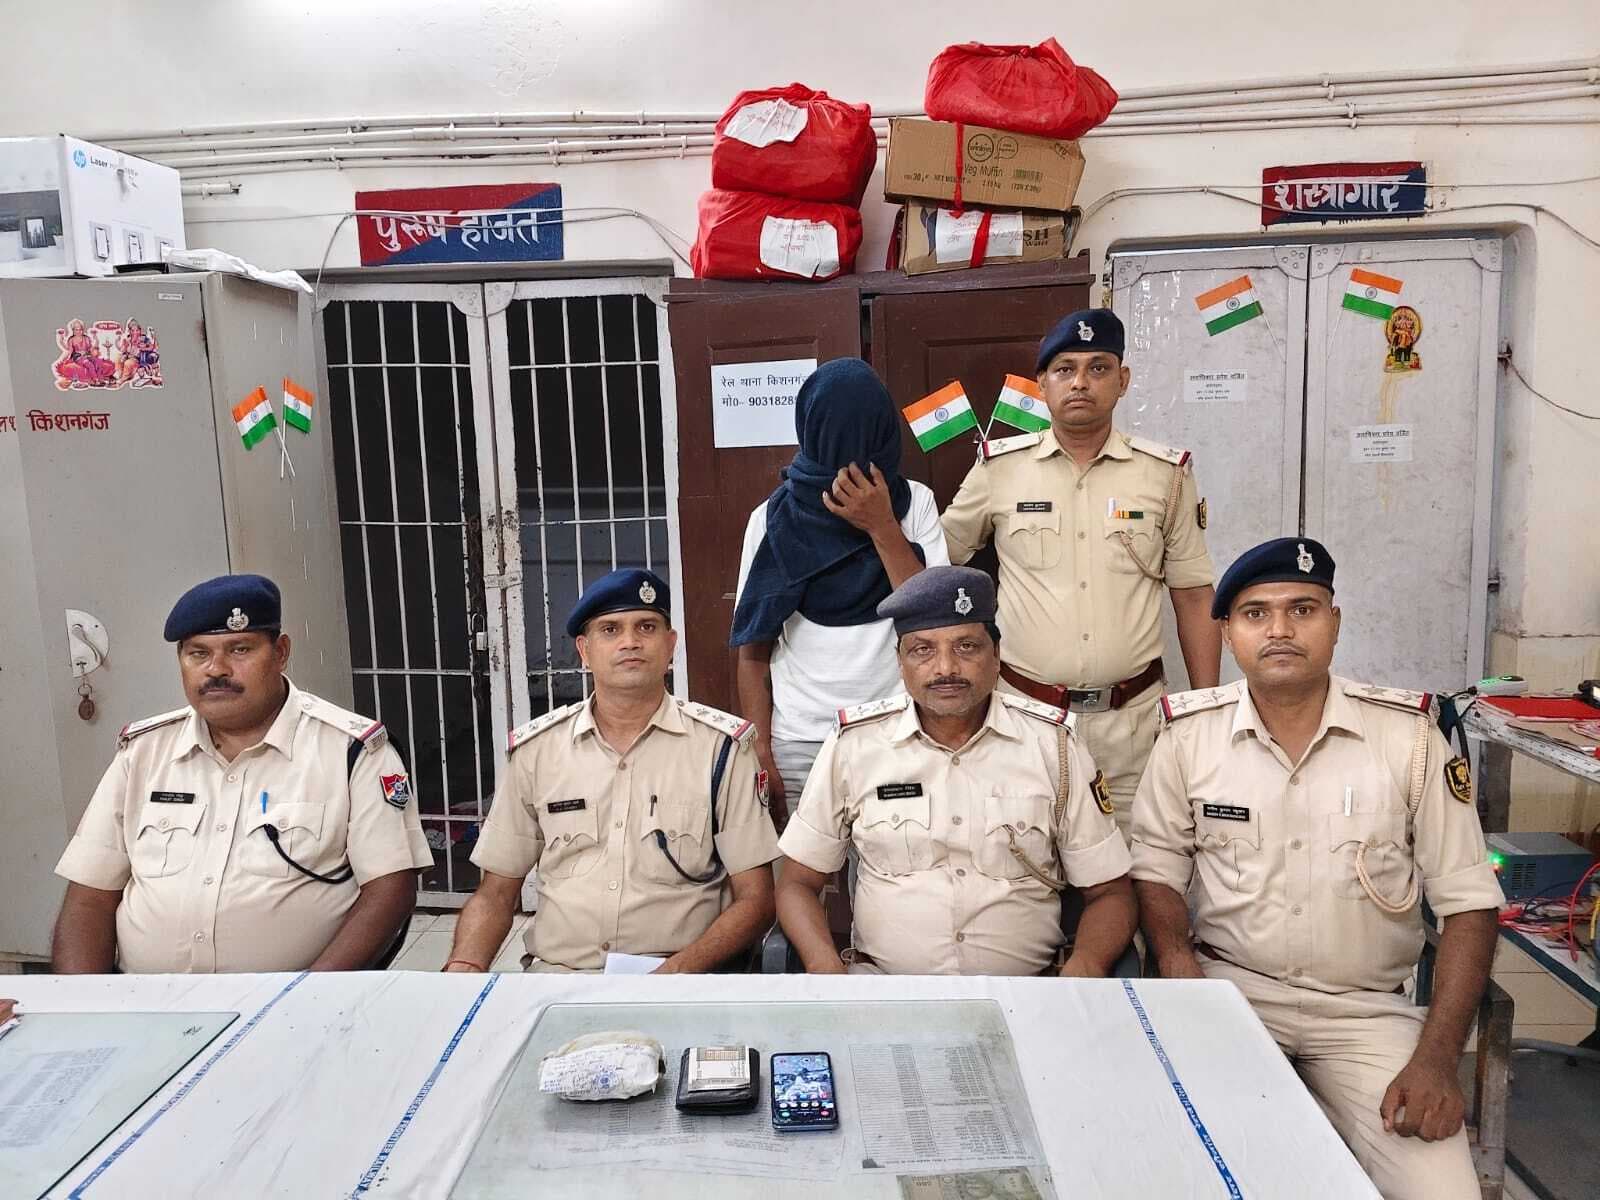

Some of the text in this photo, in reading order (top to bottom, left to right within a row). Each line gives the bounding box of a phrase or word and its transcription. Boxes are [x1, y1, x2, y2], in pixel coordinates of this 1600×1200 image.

[90, 155, 108, 168] Laser
[964, 163, 978, 177] Veg
[979, 166, 1003, 177] Muffin
[1273, 175, 1410, 211] शस्त्रागार
[459, 209, 540, 251] हाजत
[1023, 228, 1049, 241] SH
[721, 374, 808, 387] रेल थाना किशनगं
[748, 396, 797, 406] 9031828
[26, 409, 112, 432] किशनगंज
